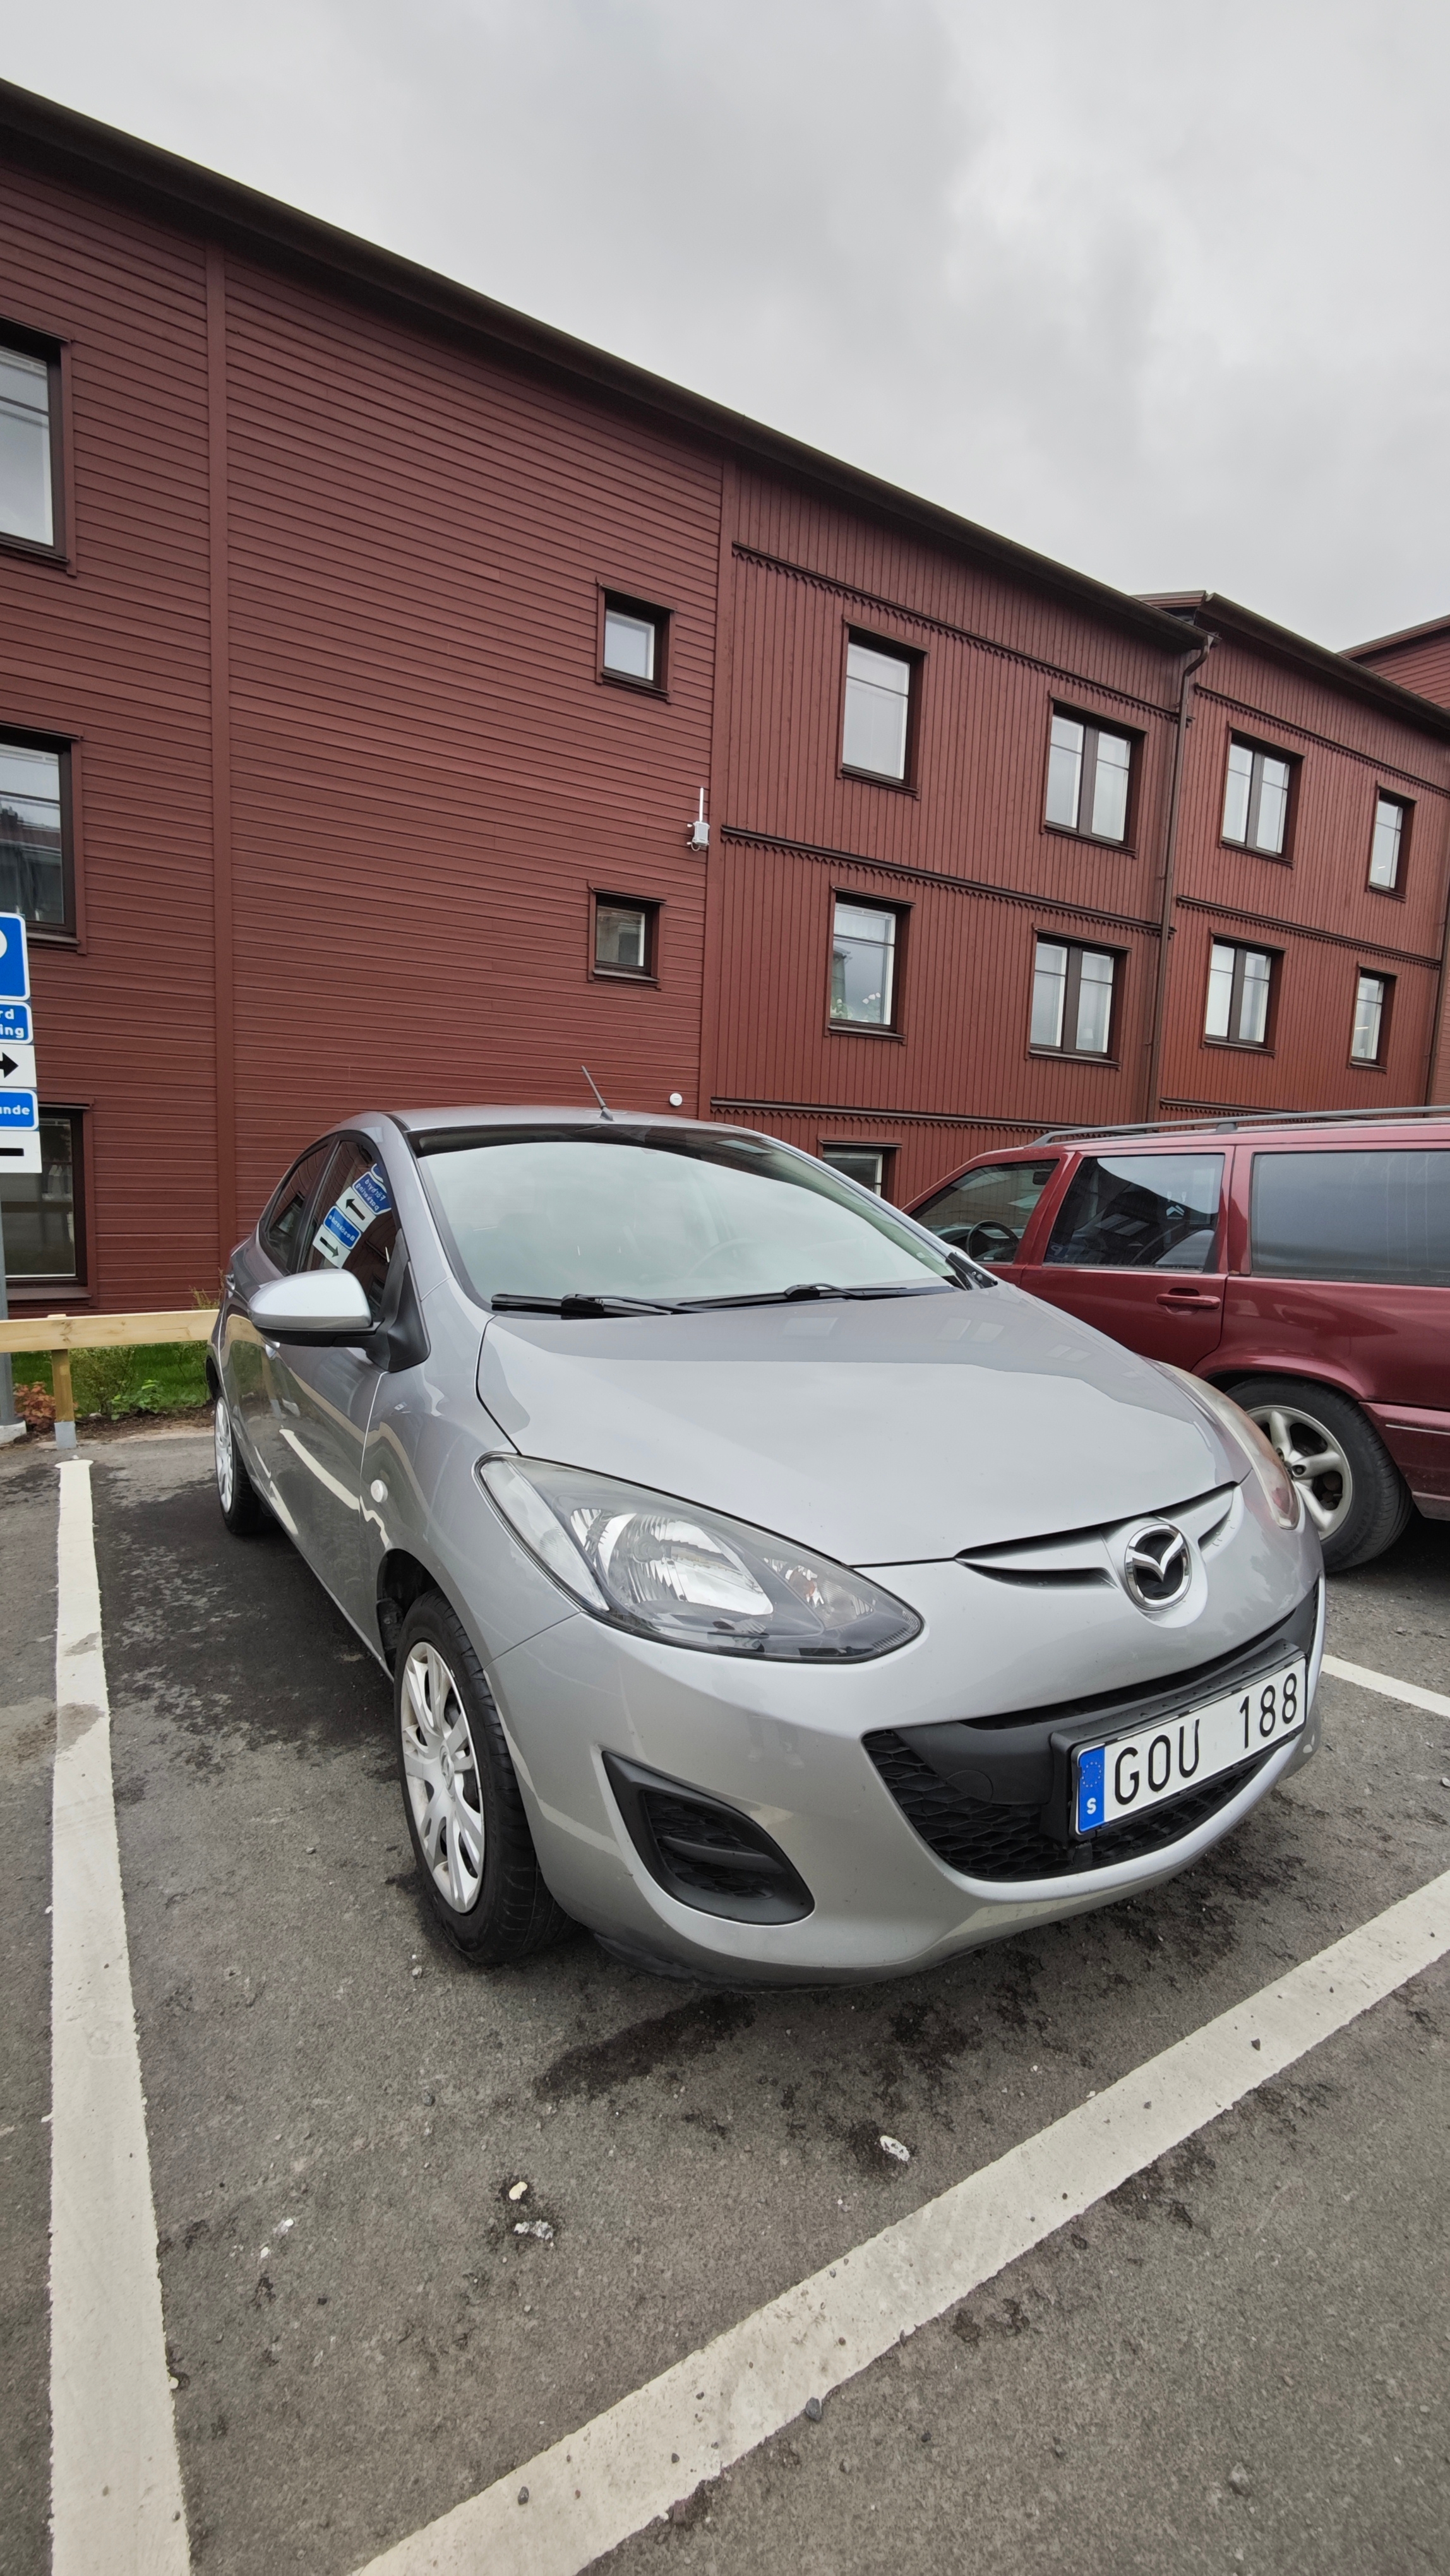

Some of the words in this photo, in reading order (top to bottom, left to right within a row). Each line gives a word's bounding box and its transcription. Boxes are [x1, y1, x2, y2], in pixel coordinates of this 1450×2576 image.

[0, 1023, 24, 1039] ing
[1115, 1718, 1200, 1805] GOU
[1239, 1673, 1297, 1749] 188
[1087, 1798, 1096, 1815] S
